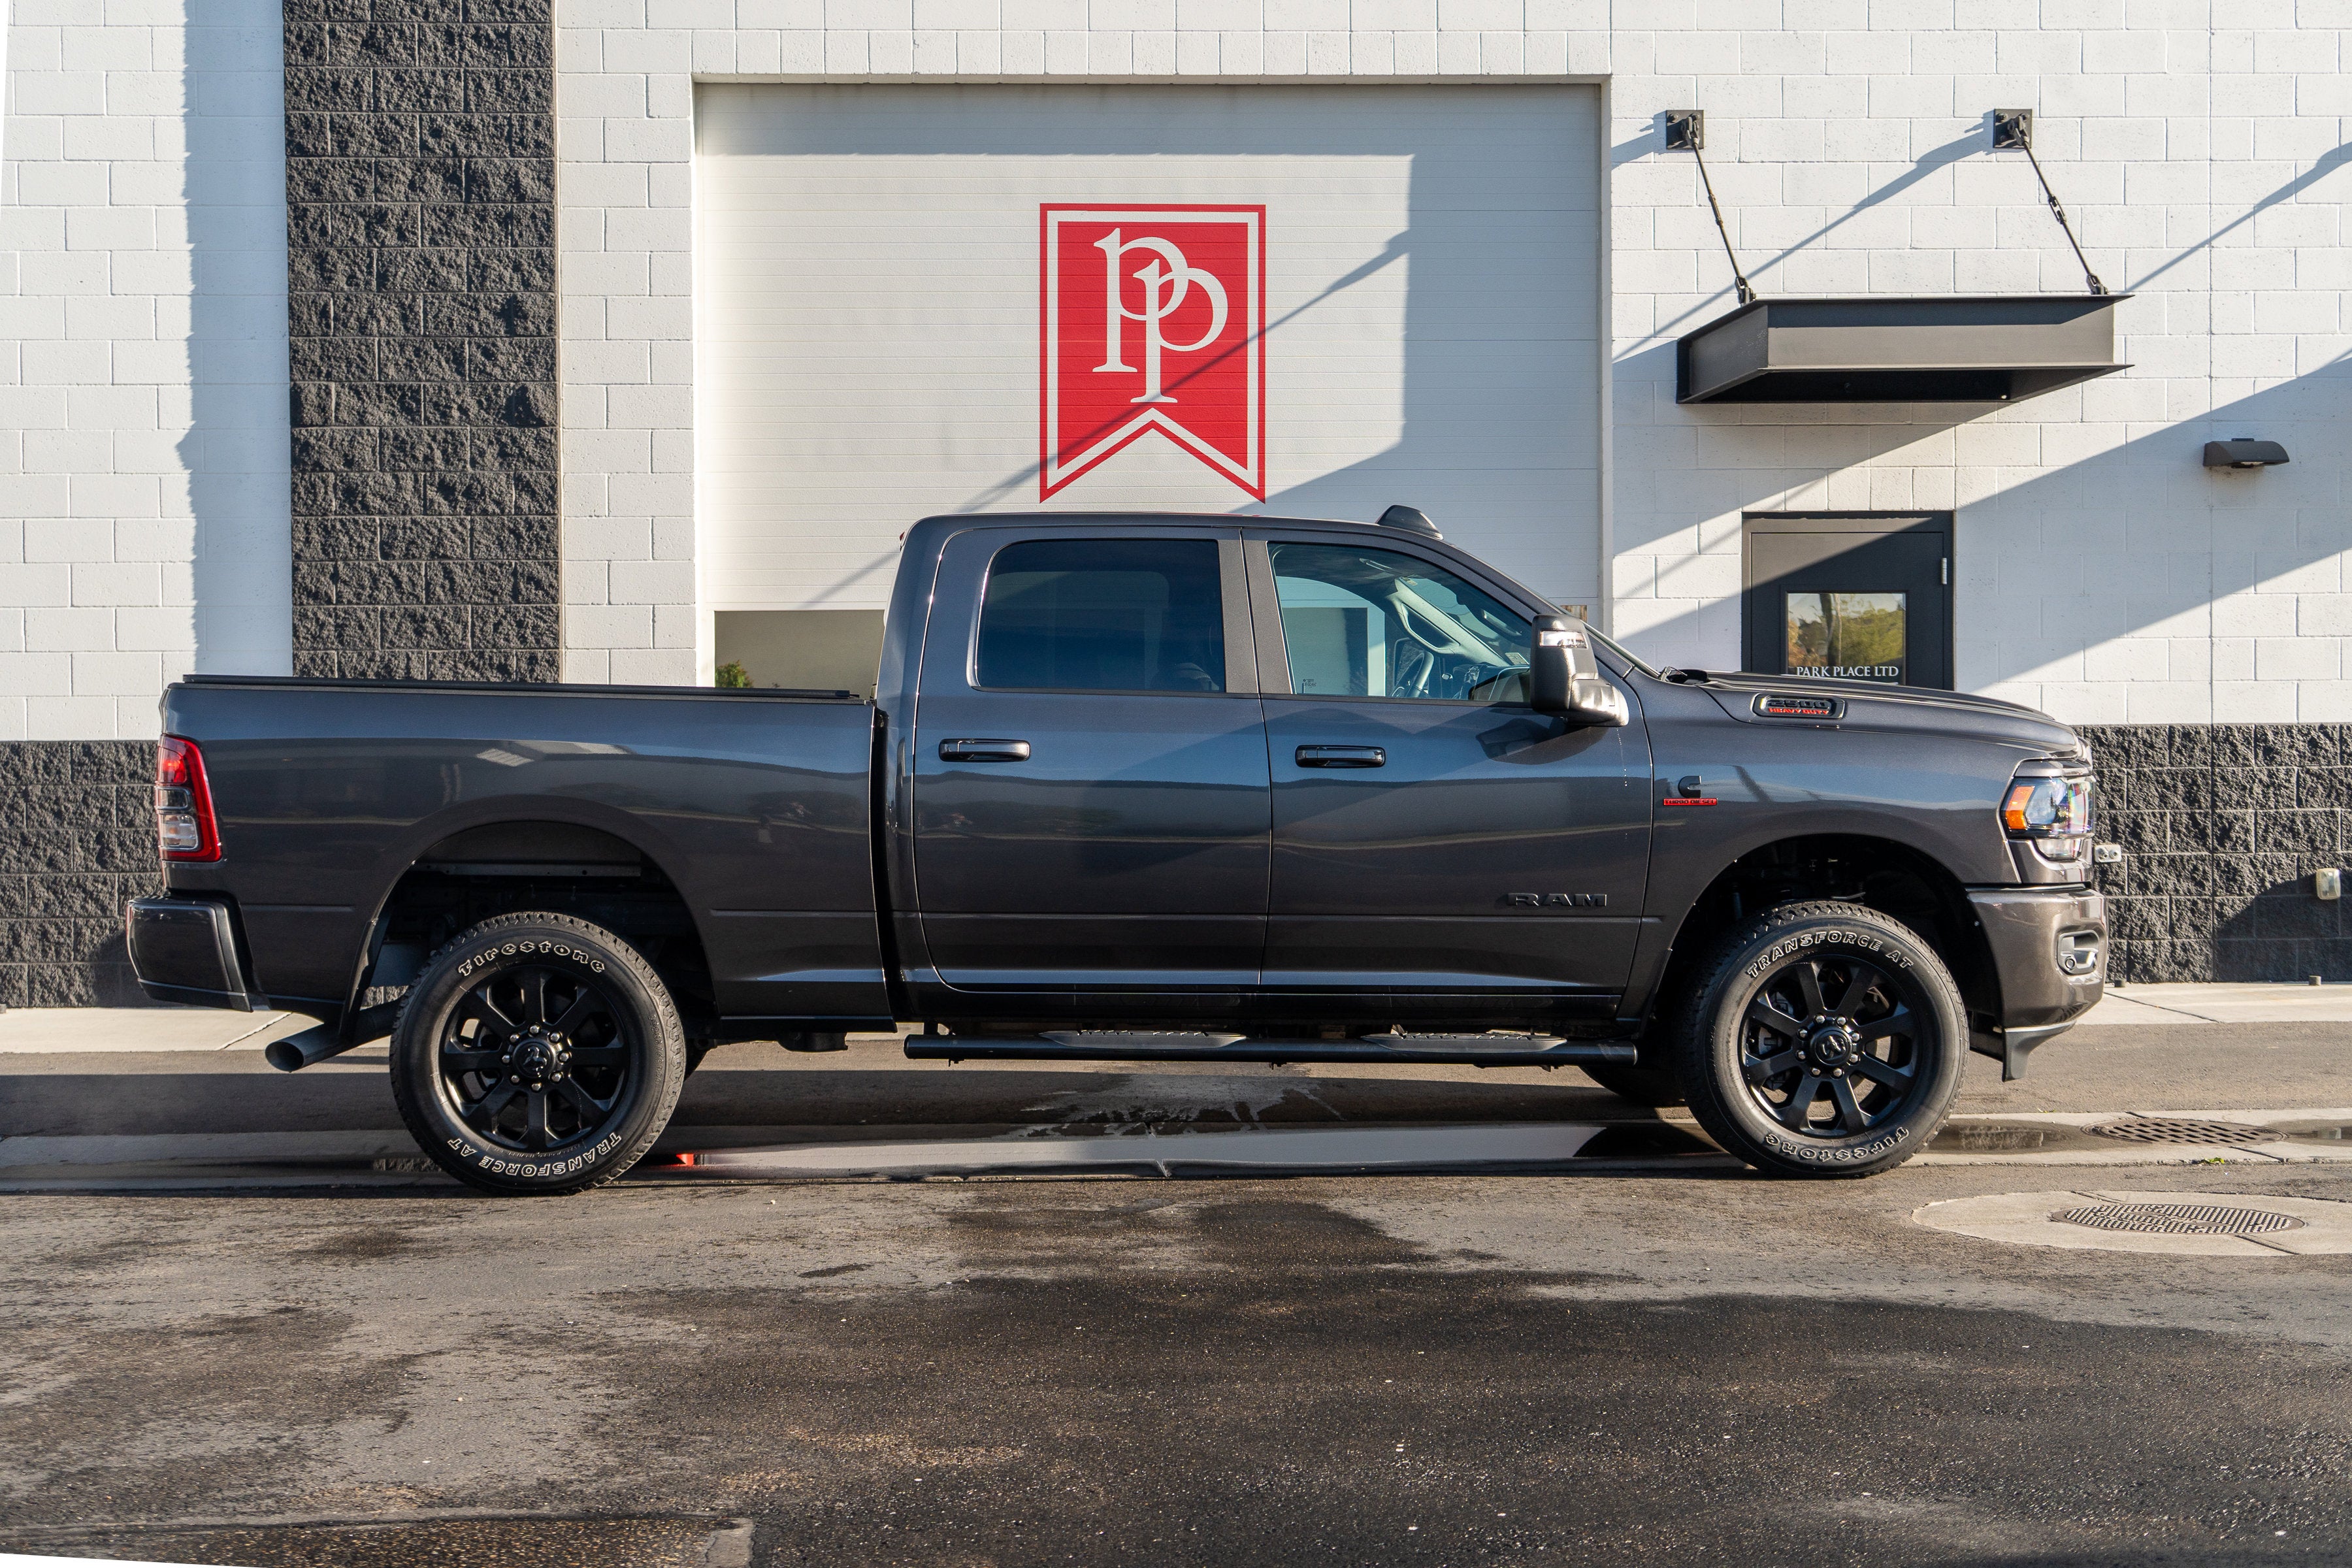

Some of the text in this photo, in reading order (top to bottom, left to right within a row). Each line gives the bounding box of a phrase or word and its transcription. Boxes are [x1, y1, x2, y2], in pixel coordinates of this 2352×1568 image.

[1797, 666, 1899, 677] PARK PLACE LTD
[1767, 699, 1829, 709] 2500
[1507, 892, 1607, 906] RAM
[458, 940, 606, 977] Firestone
[1746, 931, 1883, 978] TRANSFORCE
[1886, 949, 1914, 968] AT
[448, 1137, 478, 1157] AT
[479, 1132, 622, 1177] TRANSFORCE
[1765, 1126, 1909, 1162] Firestone
